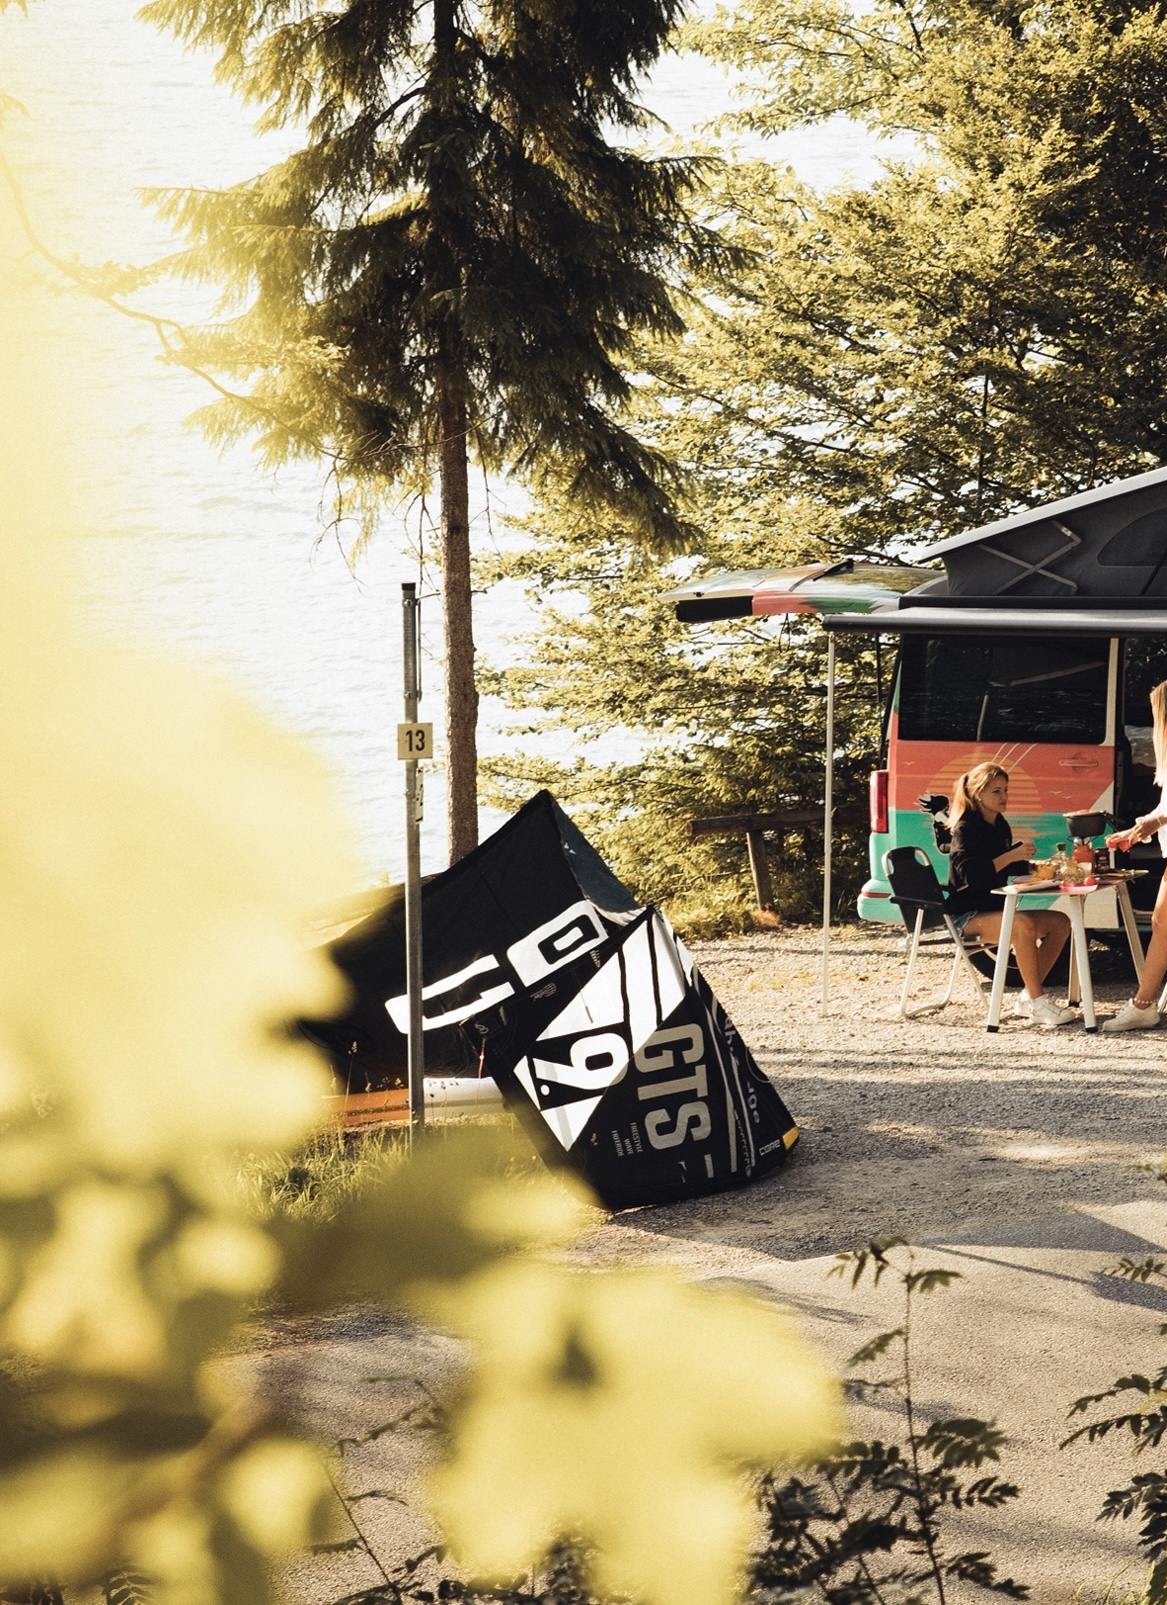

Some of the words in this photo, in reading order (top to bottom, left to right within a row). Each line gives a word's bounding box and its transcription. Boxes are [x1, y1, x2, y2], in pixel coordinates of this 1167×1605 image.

[405, 729, 425, 752] 13
[633, 1022, 712, 1151] GTS
[611, 1129, 625, 1157] FREERIDE
[624, 1138, 635, 1155] WAVE
[630, 1121, 644, 1153] FREESTYLE
